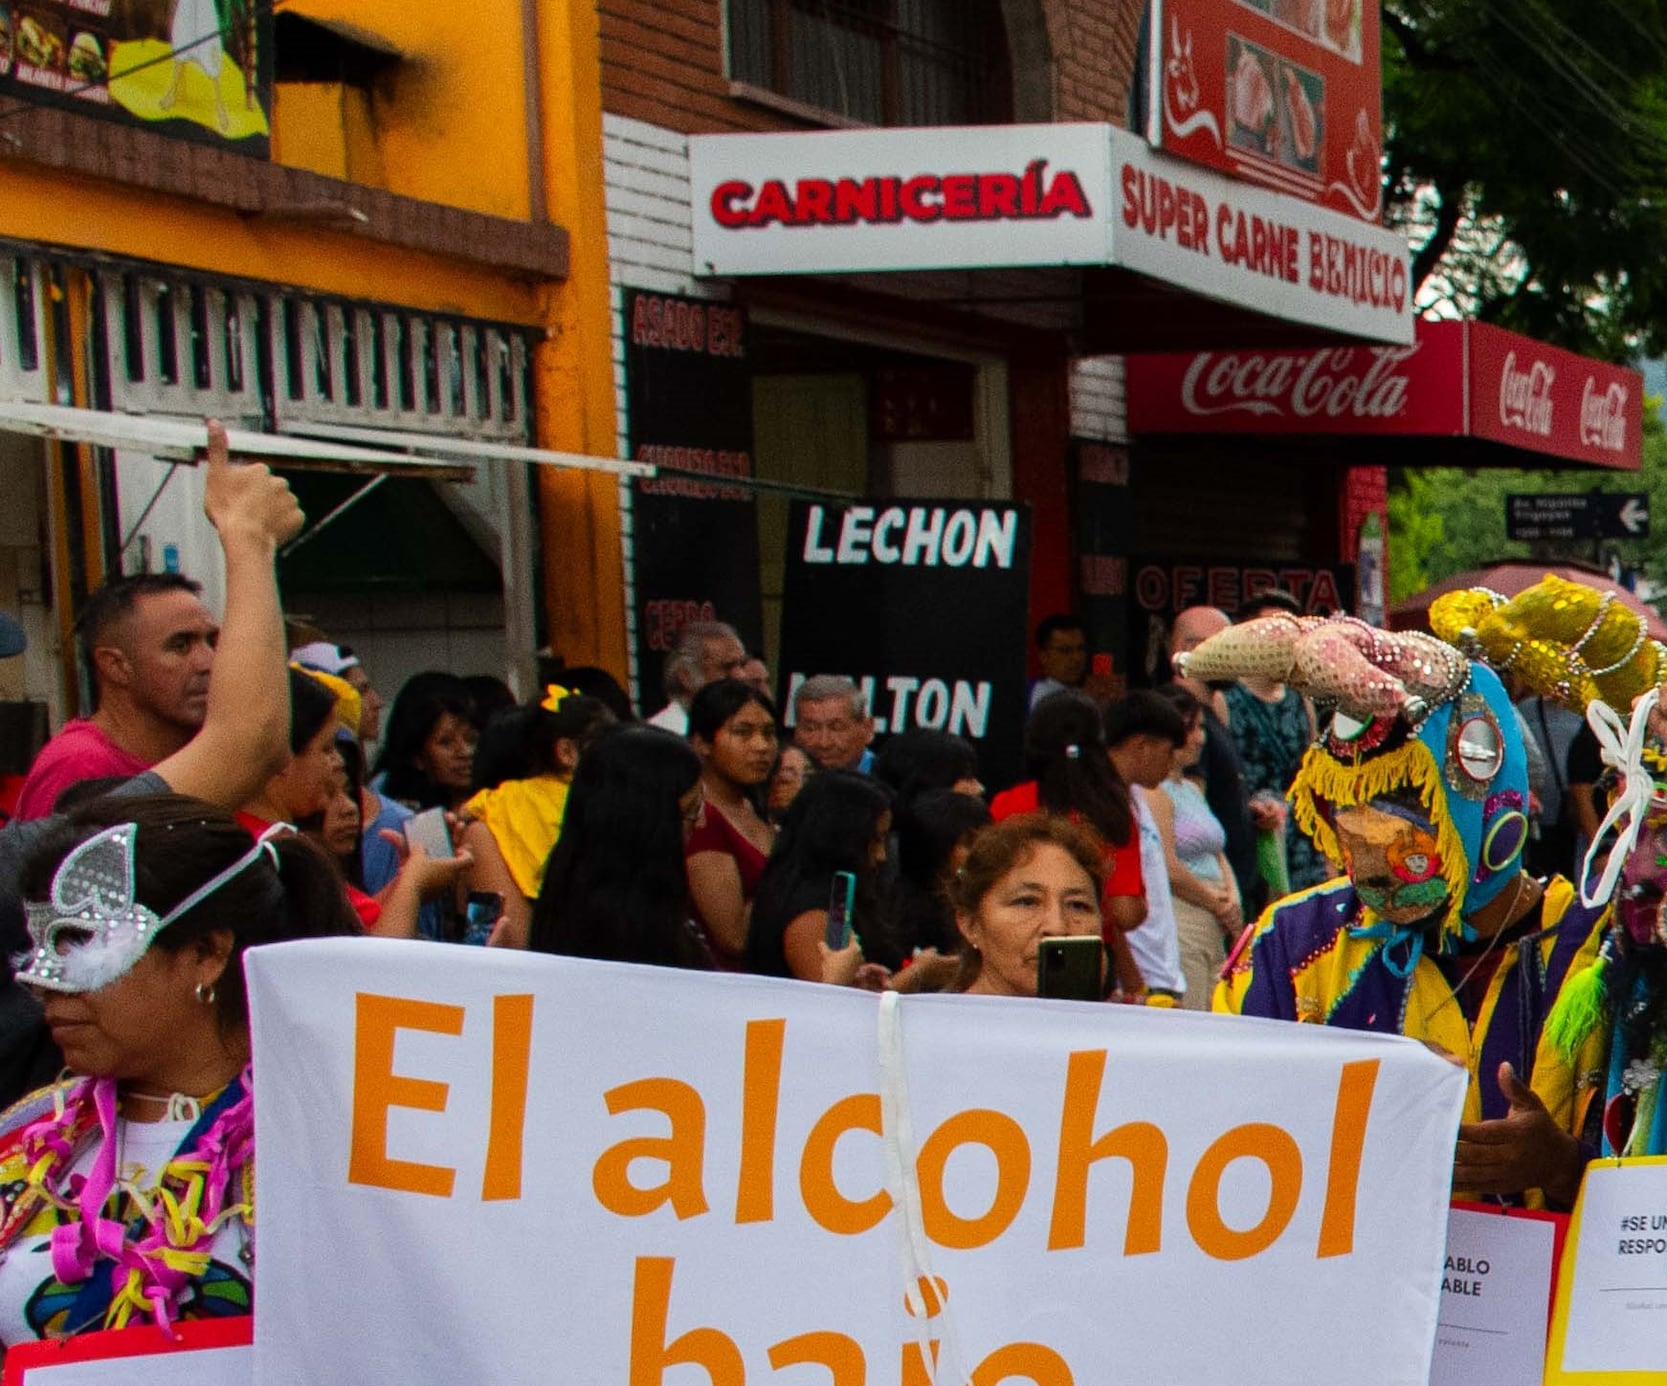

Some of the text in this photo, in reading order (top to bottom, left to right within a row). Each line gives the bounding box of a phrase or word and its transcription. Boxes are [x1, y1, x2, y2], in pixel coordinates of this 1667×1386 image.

[709, 157, 1093, 231] CARNICERÍA
[1121, 163, 1210, 256] SUPER
[1217, 202, 1299, 284] CARNE
[1182, 343, 1423, 417] Coca-Cola
[803, 504, 1018, 569] LECHON
[347, 991, 1382, 1262] El alcohol
